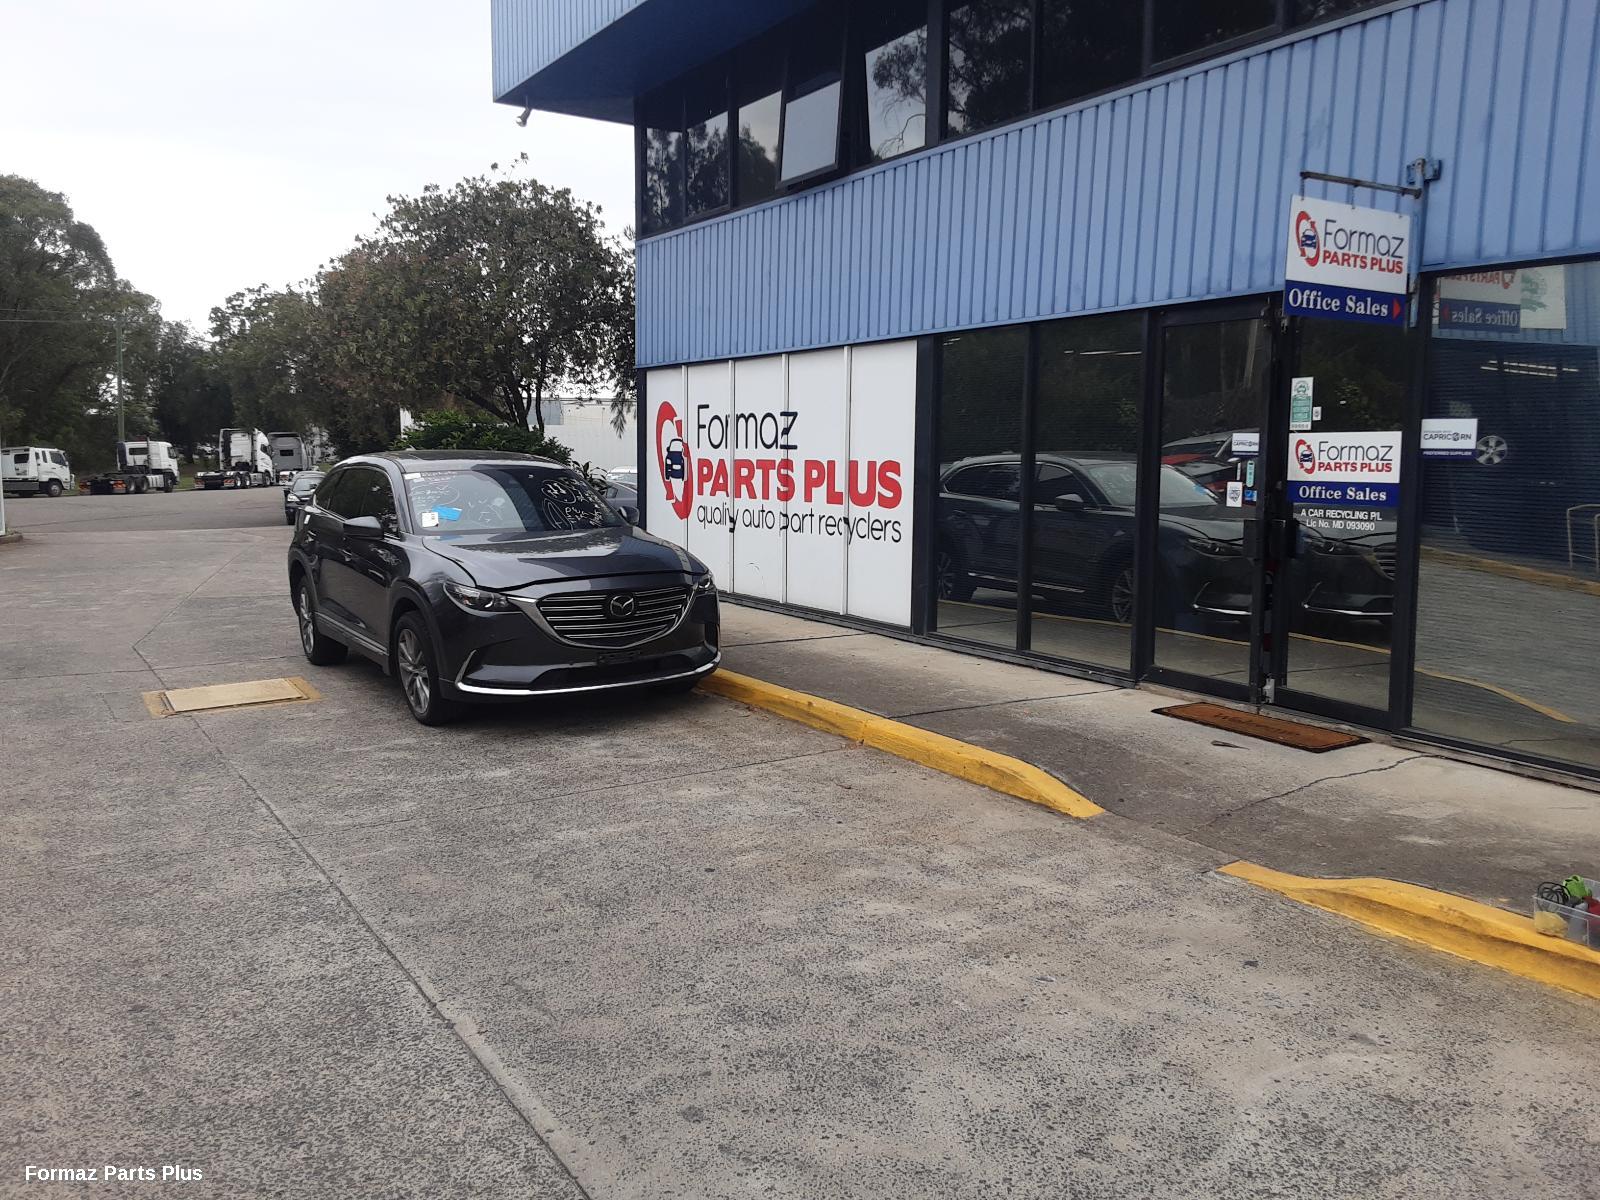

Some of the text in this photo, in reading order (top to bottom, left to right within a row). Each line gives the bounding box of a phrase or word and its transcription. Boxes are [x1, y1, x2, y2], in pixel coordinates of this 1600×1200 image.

[1323, 218, 1404, 259] Formaz
[1322, 250, 1403, 275] PARTS PLUS
[1288, 288, 1388, 317] Office Sales
[697, 404, 798, 450] Formaz
[1318, 441, 1394, 462] Formaz
[1317, 462, 1393, 473] PARTS PLUS
[697, 458, 902, 509] PARTS PLUS
[1299, 485, 1387, 501] Office Sales
[742, 504, 775, 529] auto
[779, 508, 814, 537] part
[818, 511, 901, 545] recyclers
[1300, 508, 1382, 520] A CAR RECYCLING P/L
[1306, 519, 1375, 530] Lic No. MD 093090
